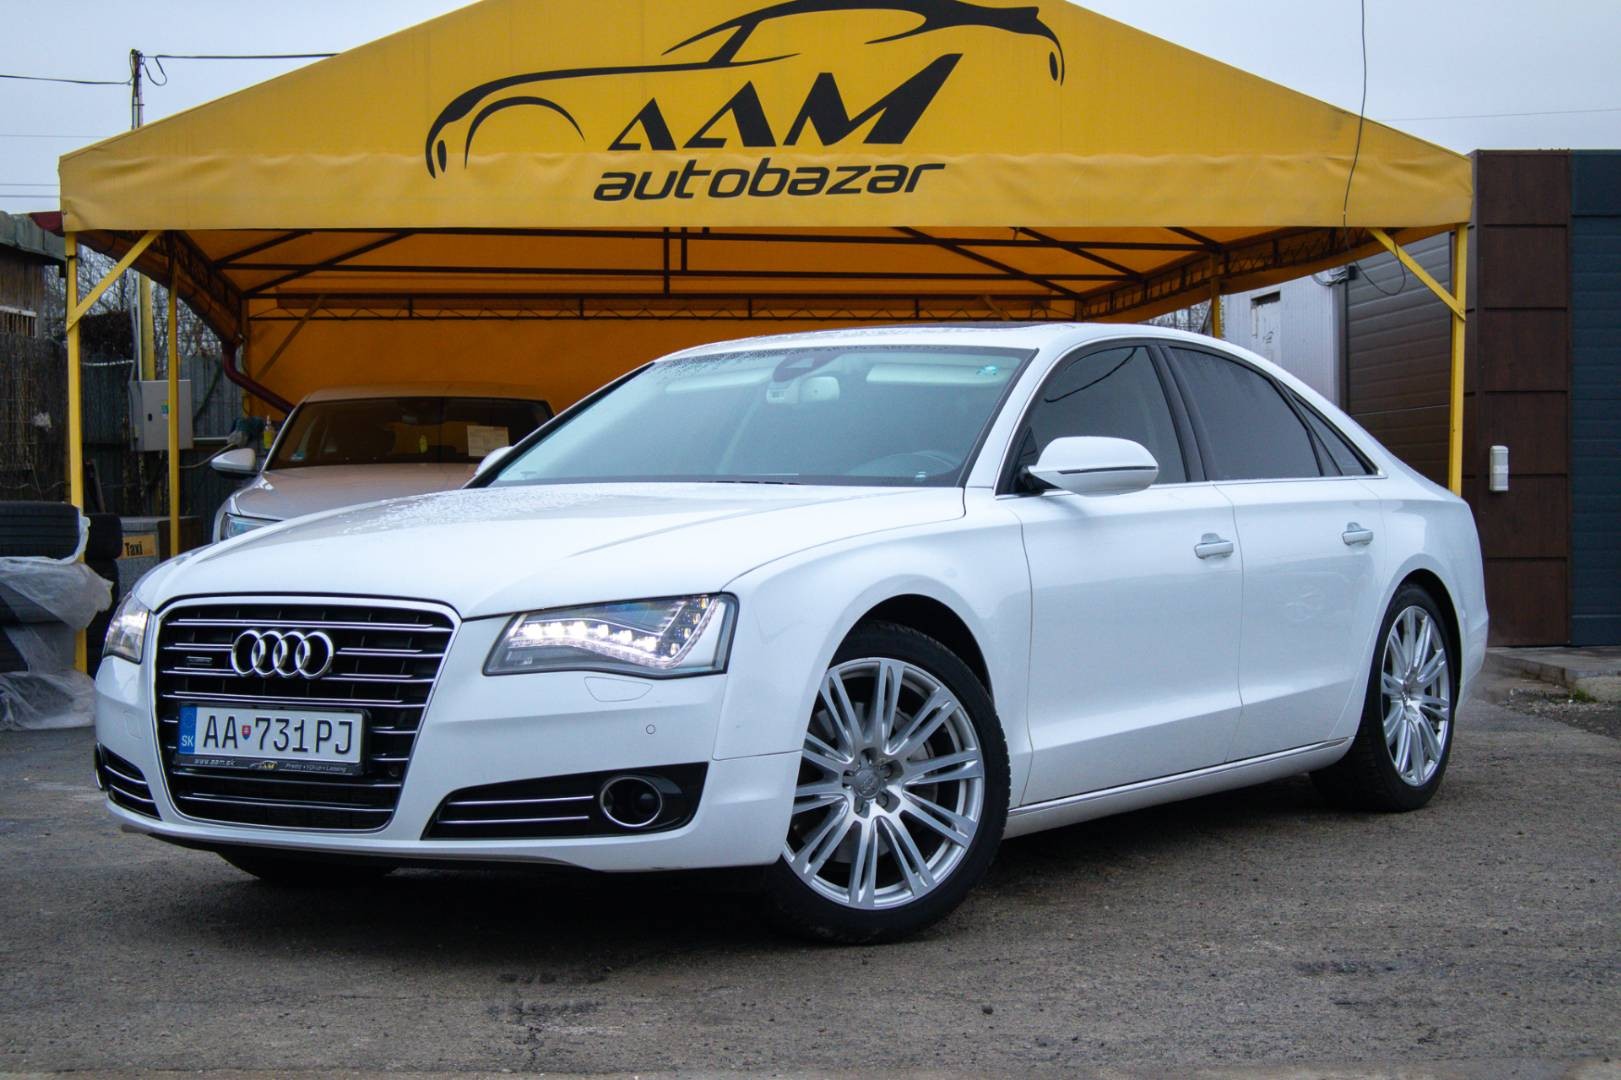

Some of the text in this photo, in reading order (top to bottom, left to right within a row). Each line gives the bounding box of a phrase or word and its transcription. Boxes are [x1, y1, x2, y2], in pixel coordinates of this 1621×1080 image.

[607, 53, 963, 150] AAM
[593, 157, 946, 201] autobazar
[125, 541, 144, 557] Taxi
[181, 735, 194, 747] SK
